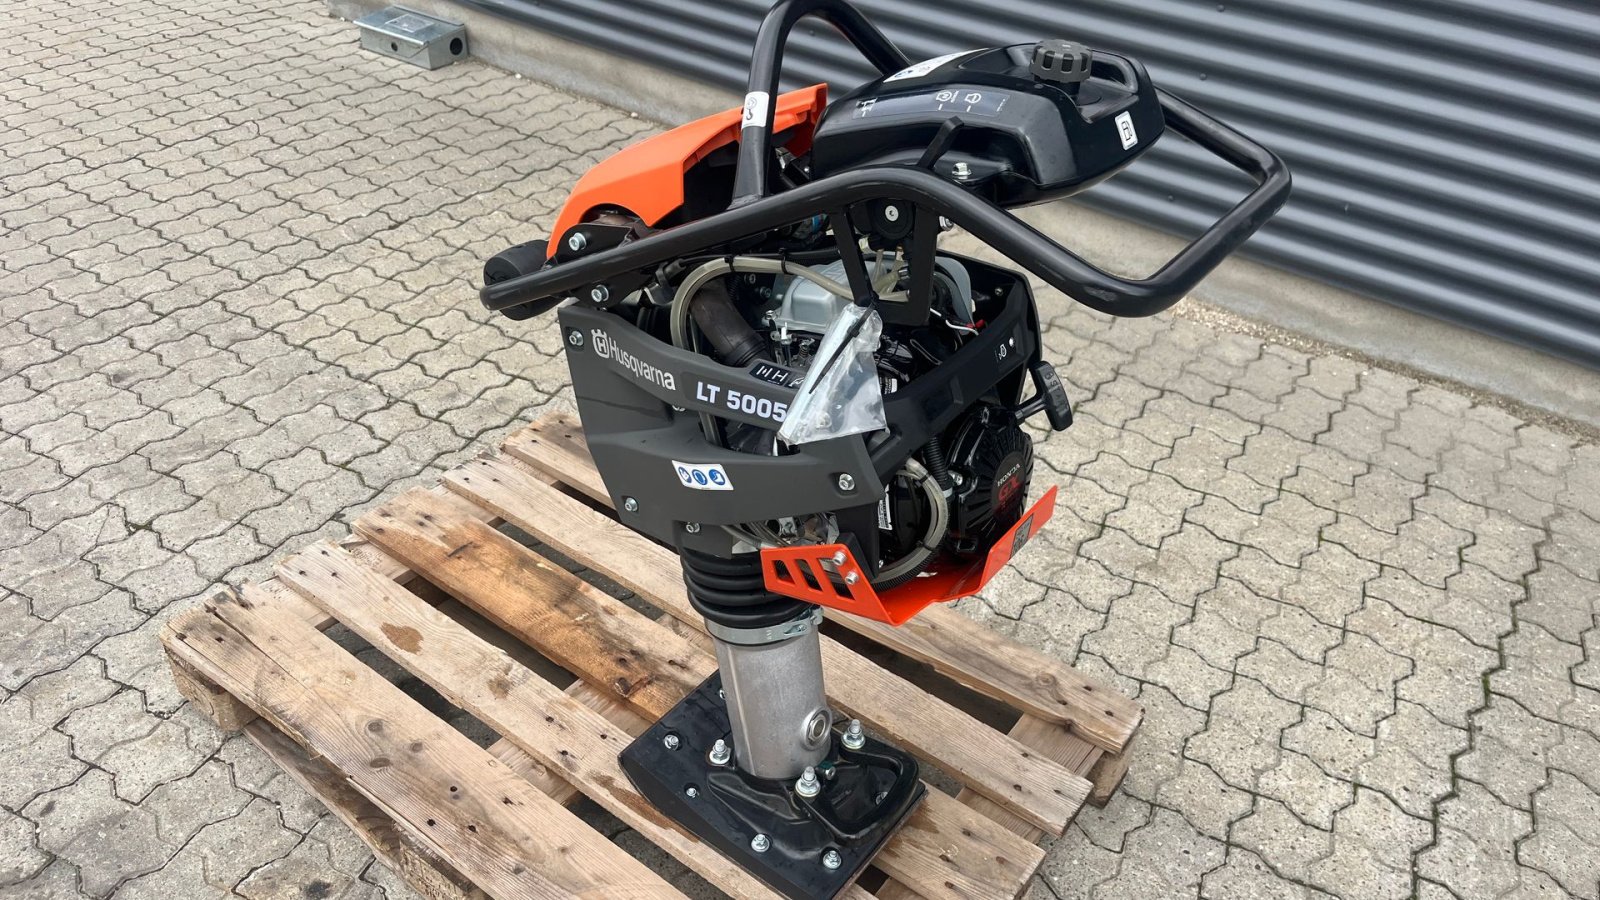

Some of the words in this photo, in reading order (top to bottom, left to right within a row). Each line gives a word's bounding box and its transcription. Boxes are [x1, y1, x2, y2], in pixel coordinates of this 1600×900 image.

[608, 336, 676, 390] Husqvarna
[696, 381, 721, 404] LT
[726, 389, 788, 423] 5005
[997, 463, 1020, 487] HONDA
